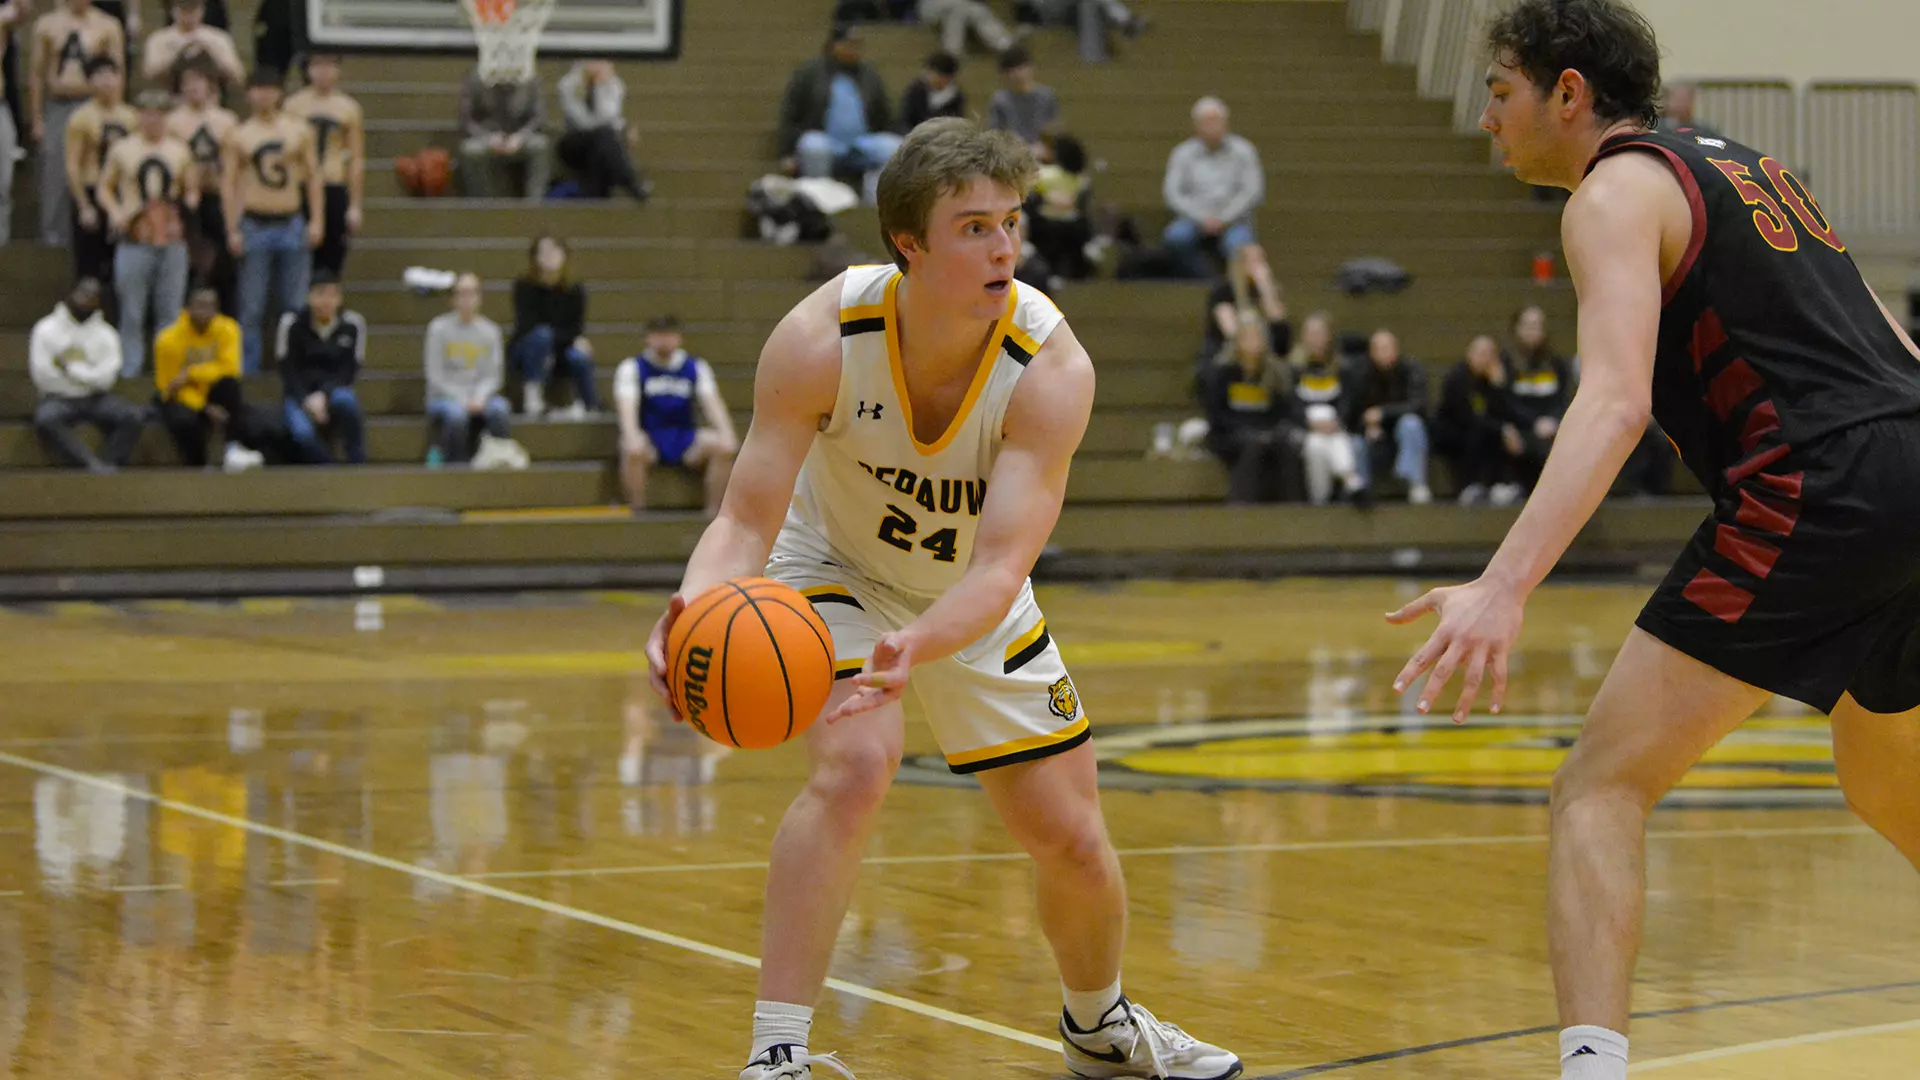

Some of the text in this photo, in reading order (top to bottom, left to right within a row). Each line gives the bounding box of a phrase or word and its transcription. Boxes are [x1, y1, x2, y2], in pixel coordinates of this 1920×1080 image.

[58, 29, 88, 78] A
[252, 140, 289, 189] G
[307, 115, 340, 164] T
[1706, 157, 1846, 252] 50
[877, 503, 958, 563] 24
[685, 644, 714, 740] Wilso
